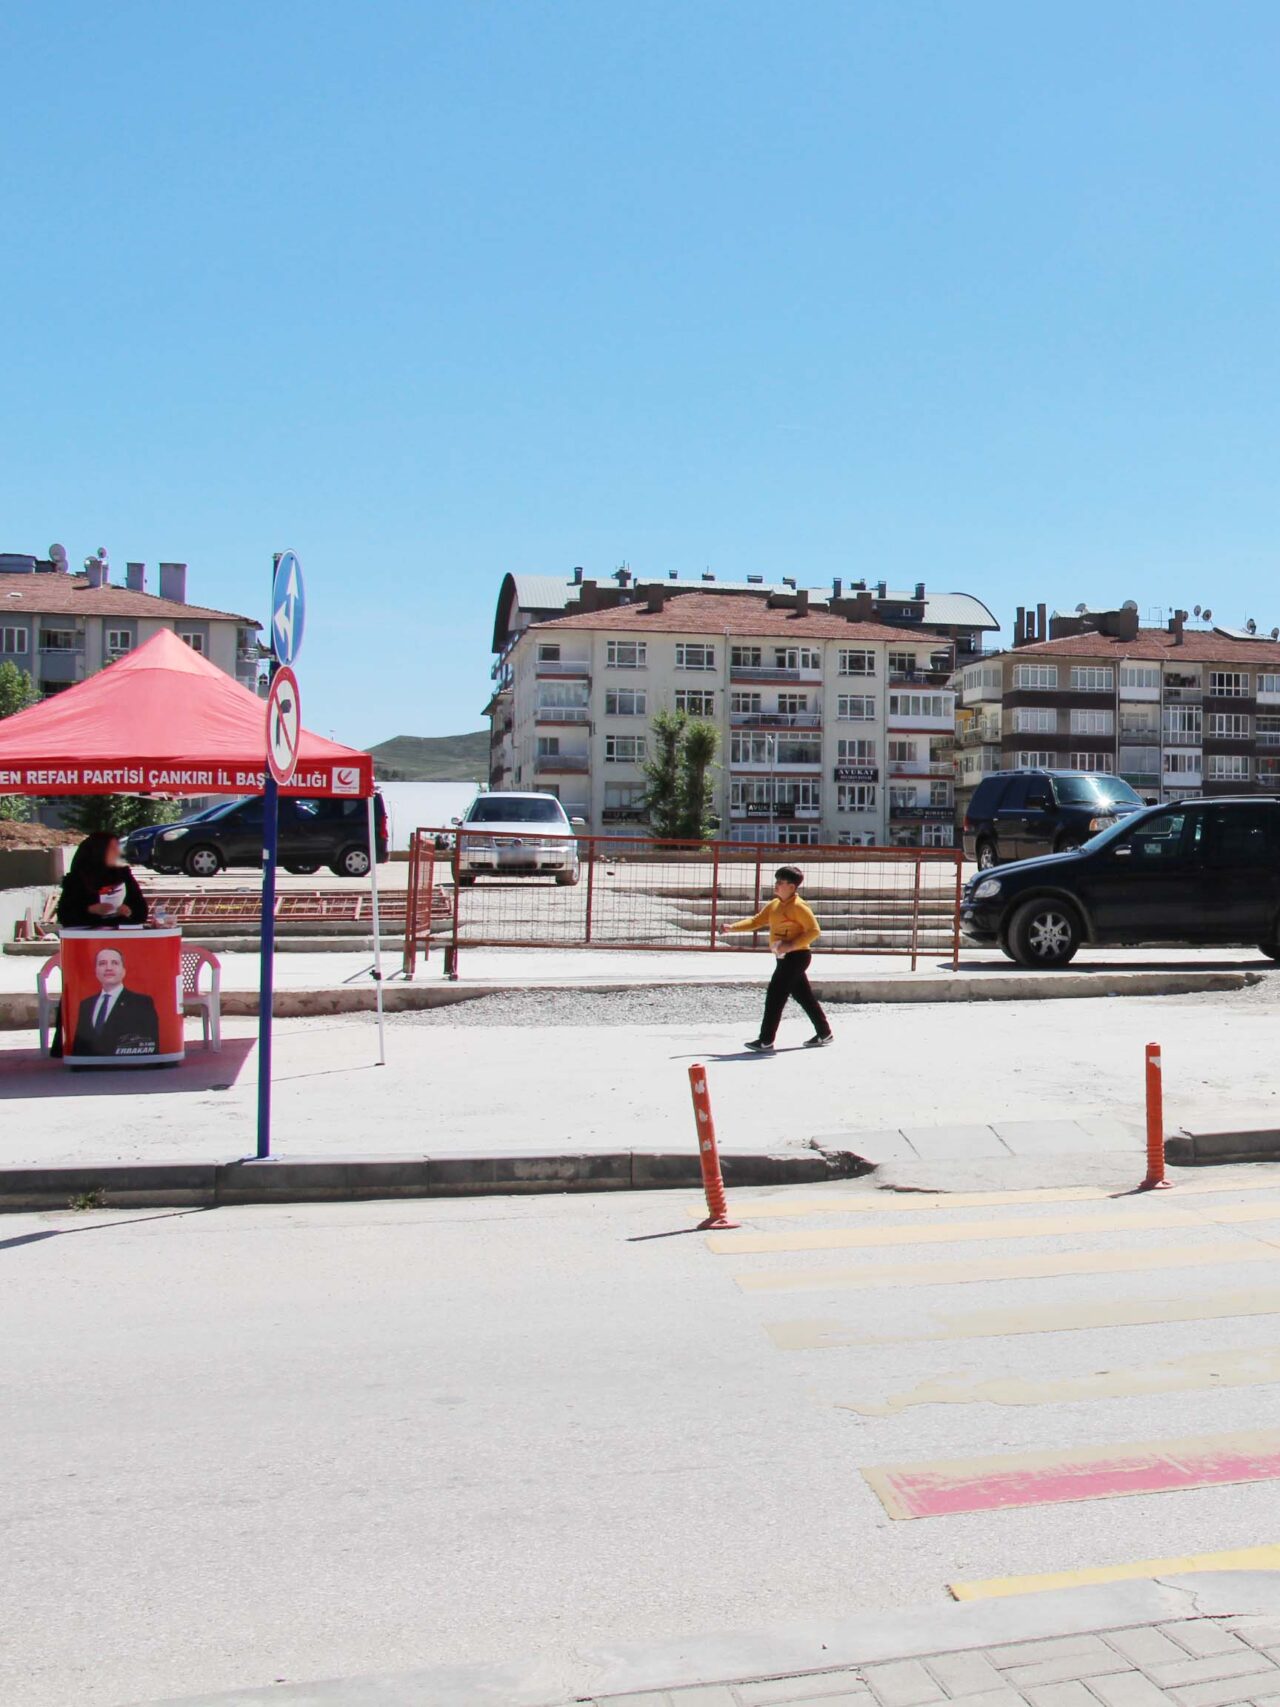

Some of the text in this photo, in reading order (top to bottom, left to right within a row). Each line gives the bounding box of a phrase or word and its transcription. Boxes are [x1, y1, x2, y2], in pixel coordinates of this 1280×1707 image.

[0, 767, 327, 789] EN REFAH PARTİSİ ÇANKIRI İL BAŞNLIĞI
[115, 1047, 155, 1055] ERBAKAN
